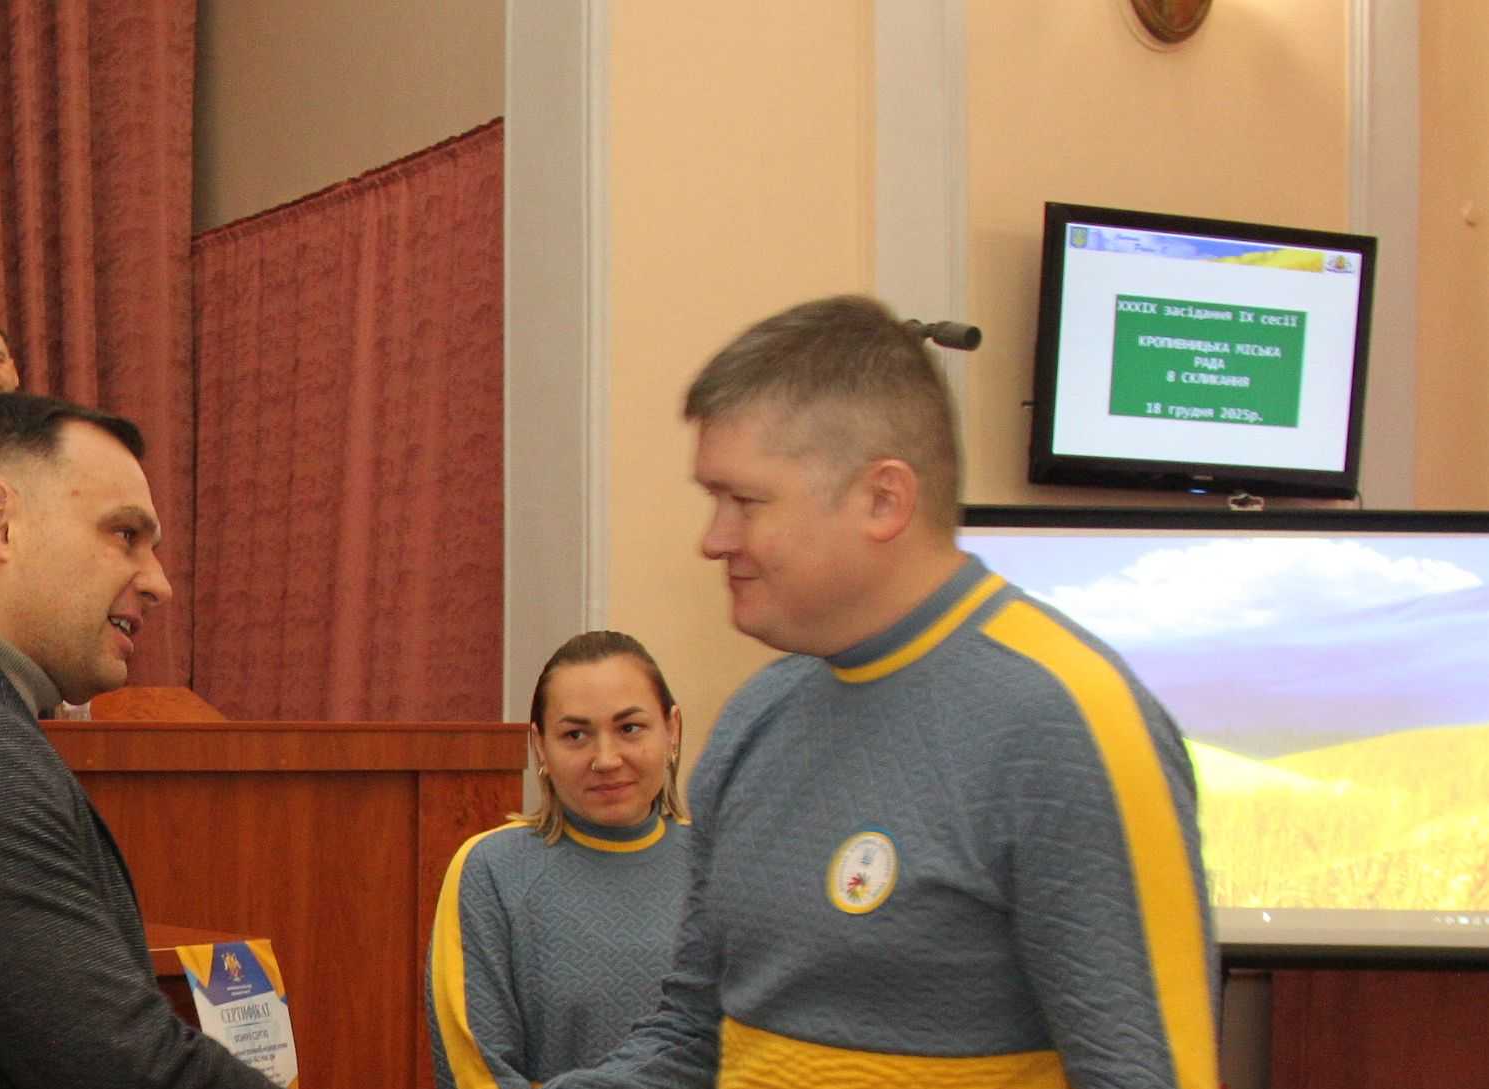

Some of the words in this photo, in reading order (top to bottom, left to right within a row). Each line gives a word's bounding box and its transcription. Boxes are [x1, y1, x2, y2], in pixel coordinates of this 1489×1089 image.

[1164, 305, 1233, 321] засідання
[1261, 315, 1298, 327] сесії
[1138, 335, 1230, 354] КРОПИВНИЦЬКА
[1235, 343, 1282, 358] МІСЬКА
[1193, 356, 1225, 370] РАДА
[1181, 371, 1250, 388] СКЛИКАННЯ
[1146, 402, 1162, 415] 18
[1168, 404, 1214, 420] грудня
[1220, 406, 1263, 423] 2025р.
